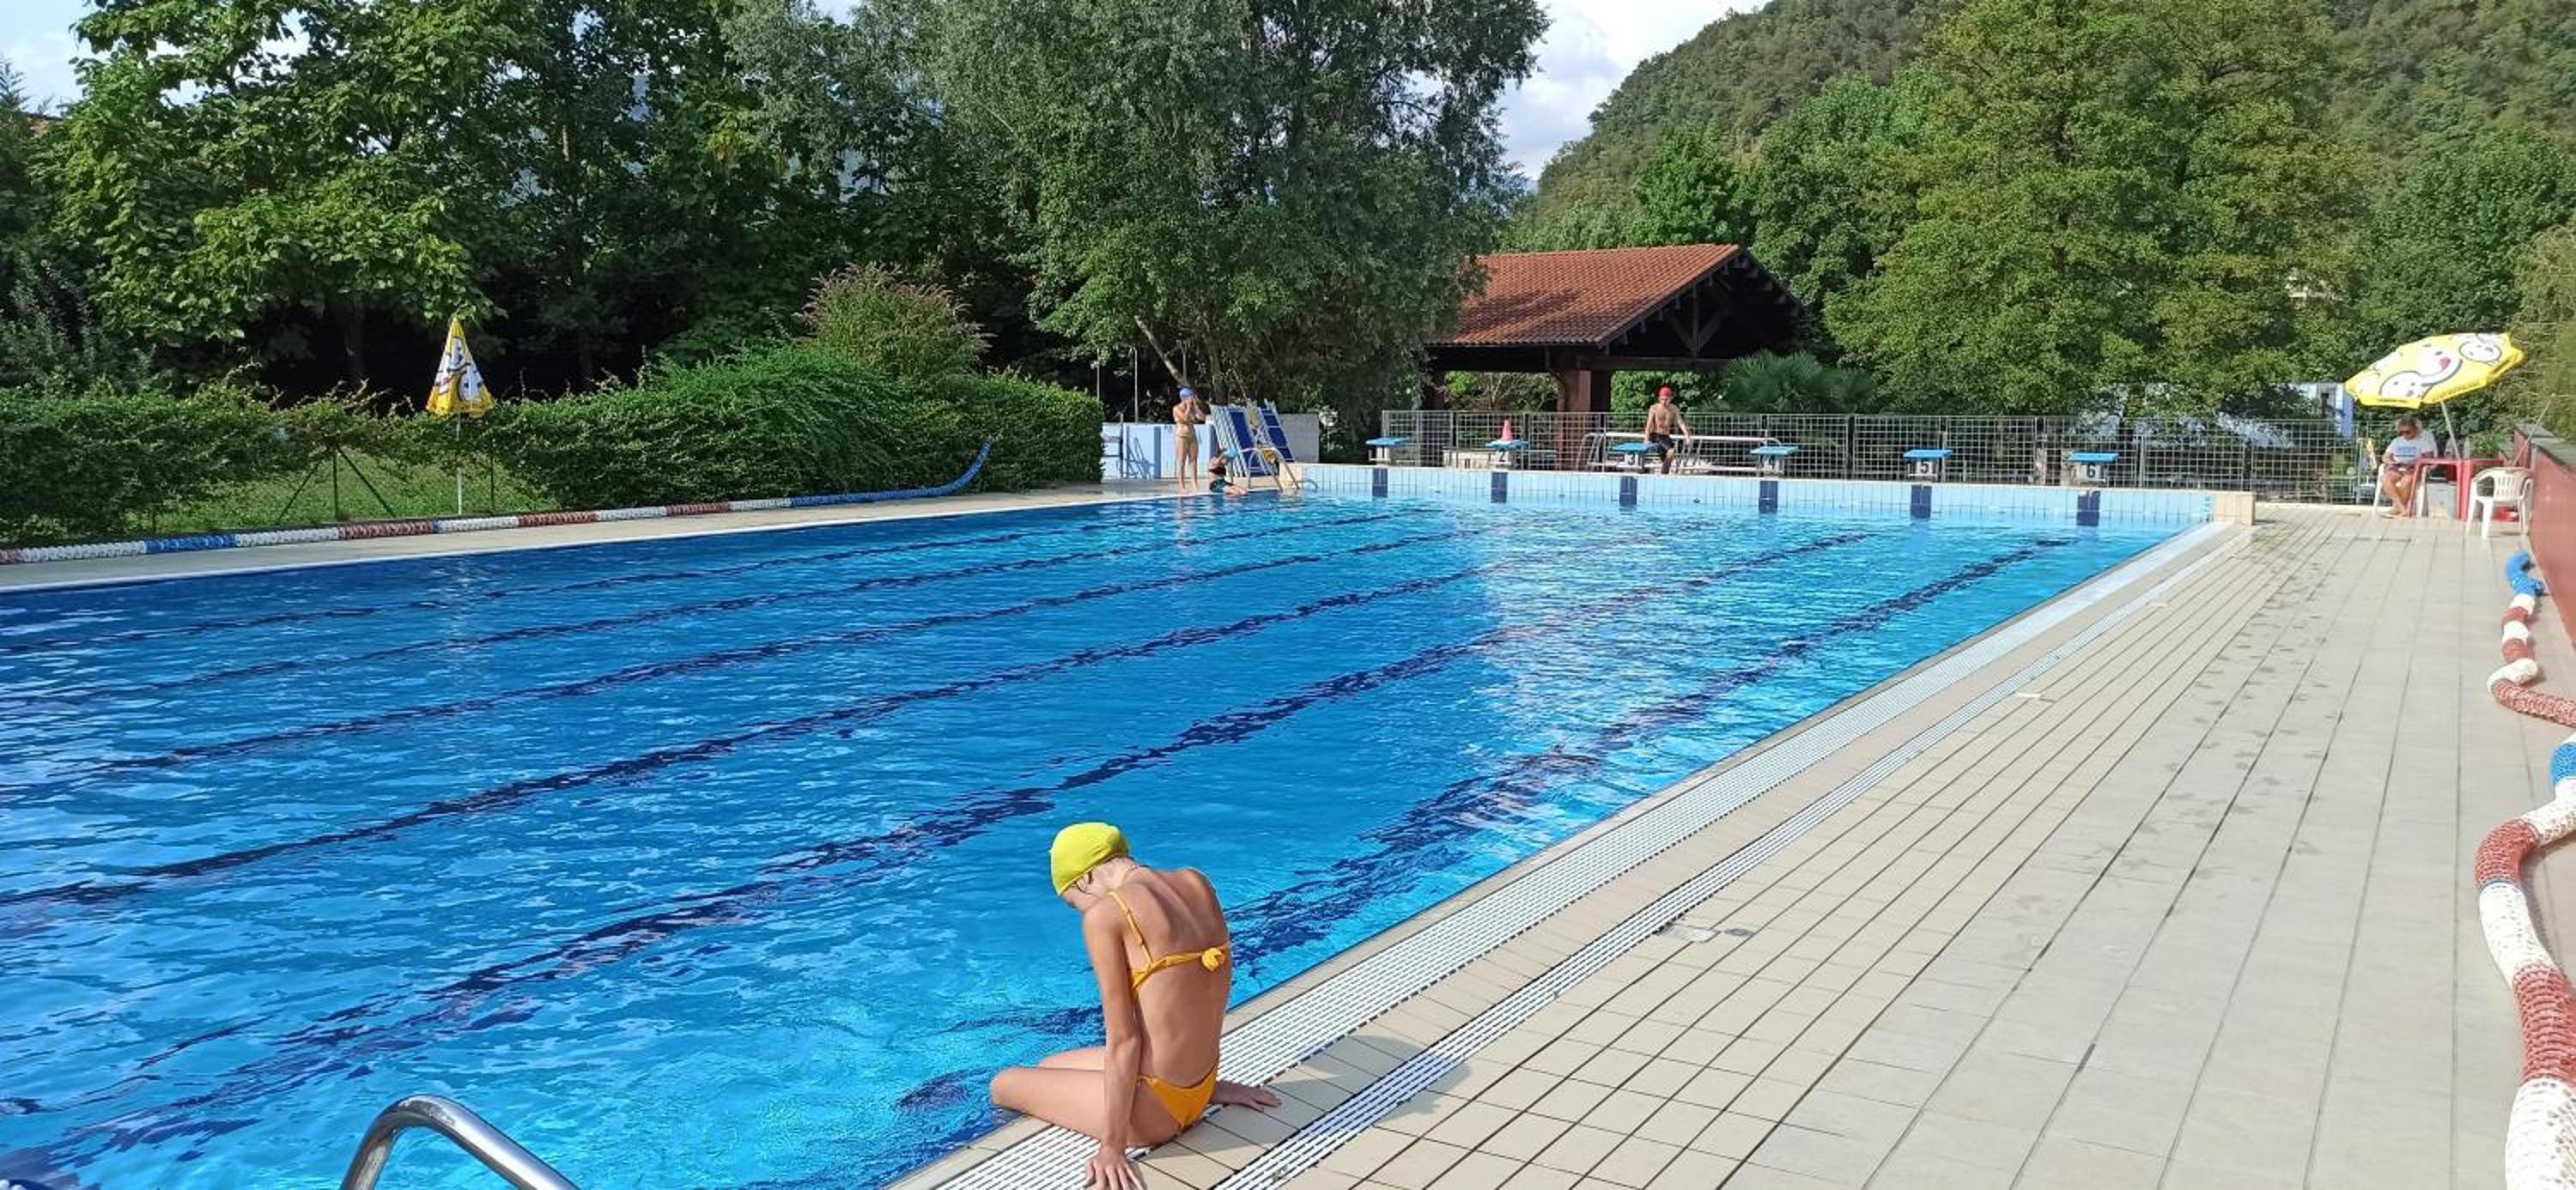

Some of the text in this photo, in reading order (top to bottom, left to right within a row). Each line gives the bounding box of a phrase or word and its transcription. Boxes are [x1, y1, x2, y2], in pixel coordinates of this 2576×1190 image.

[1498, 449, 1506, 462] 2
[1628, 452, 1636, 465] 3
[1921, 460, 1929, 474] 5
[2087, 463, 2096, 478] 6
